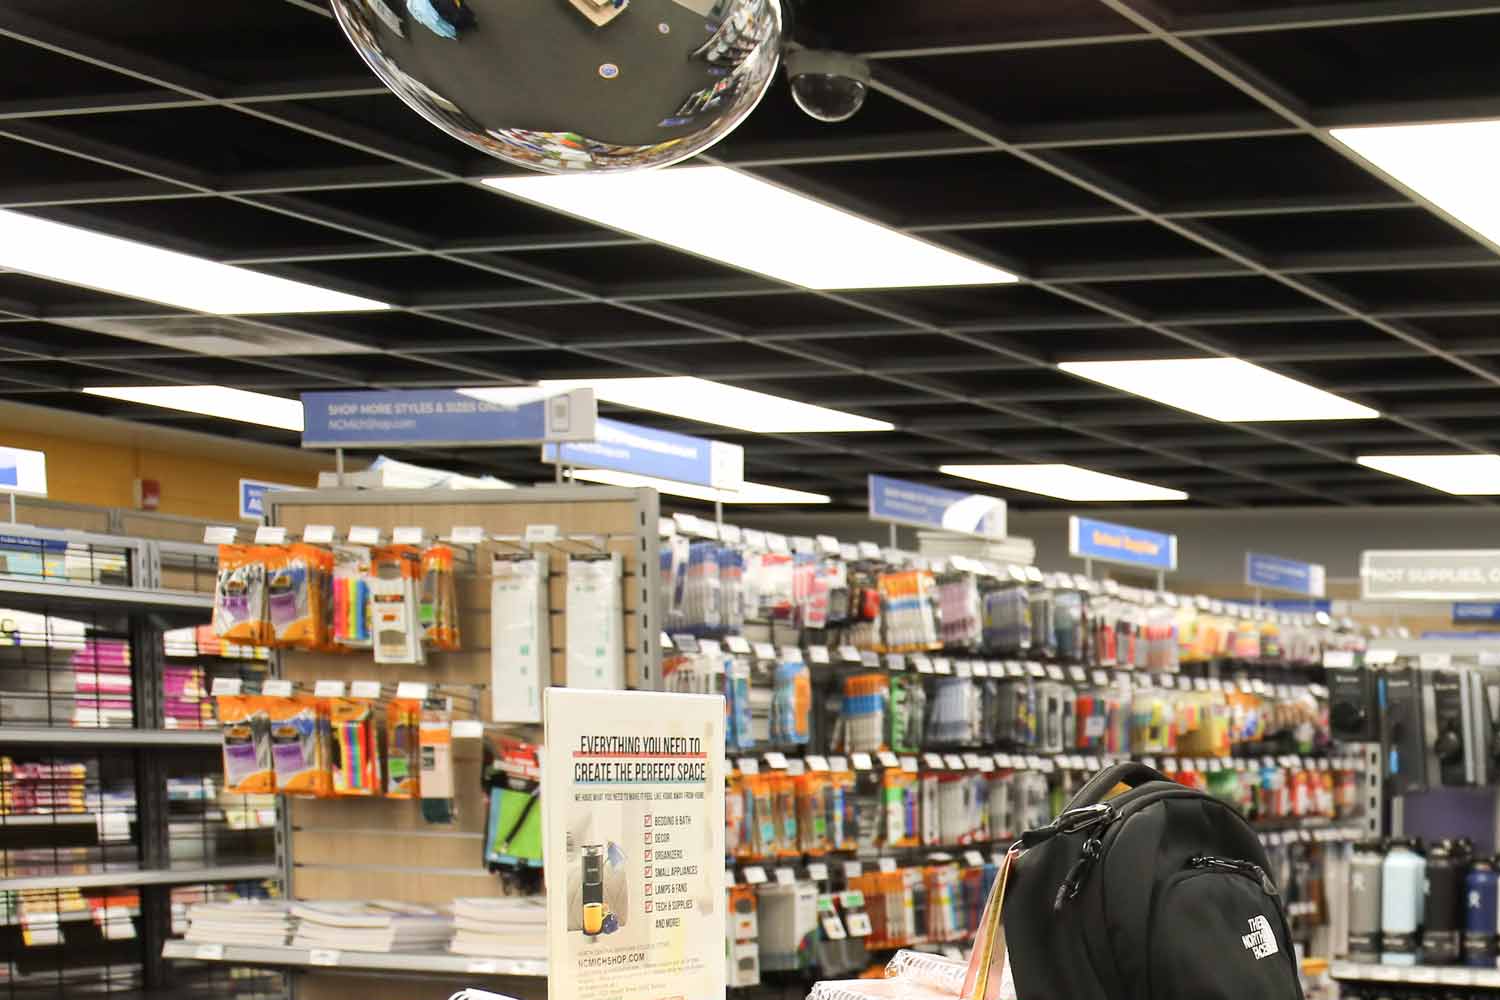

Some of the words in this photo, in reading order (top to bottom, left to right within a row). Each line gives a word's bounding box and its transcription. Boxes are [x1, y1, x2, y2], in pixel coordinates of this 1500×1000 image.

[581, 736, 640, 755] EVERYTHING
[643, 737, 661, 754] YOU
[663, 737, 687, 755] NEED
[689, 738, 700, 755] TO
[575, 763, 612, 781] CREATE
[615, 763, 633, 781] THE
[635, 763, 675, 781] PERFECT
[677, 763, 705, 780] SPACE
[1248, 916, 1264, 932] THE
[1242, 930, 1264, 949] NORTH
[1252, 944, 1269, 960] FACE
